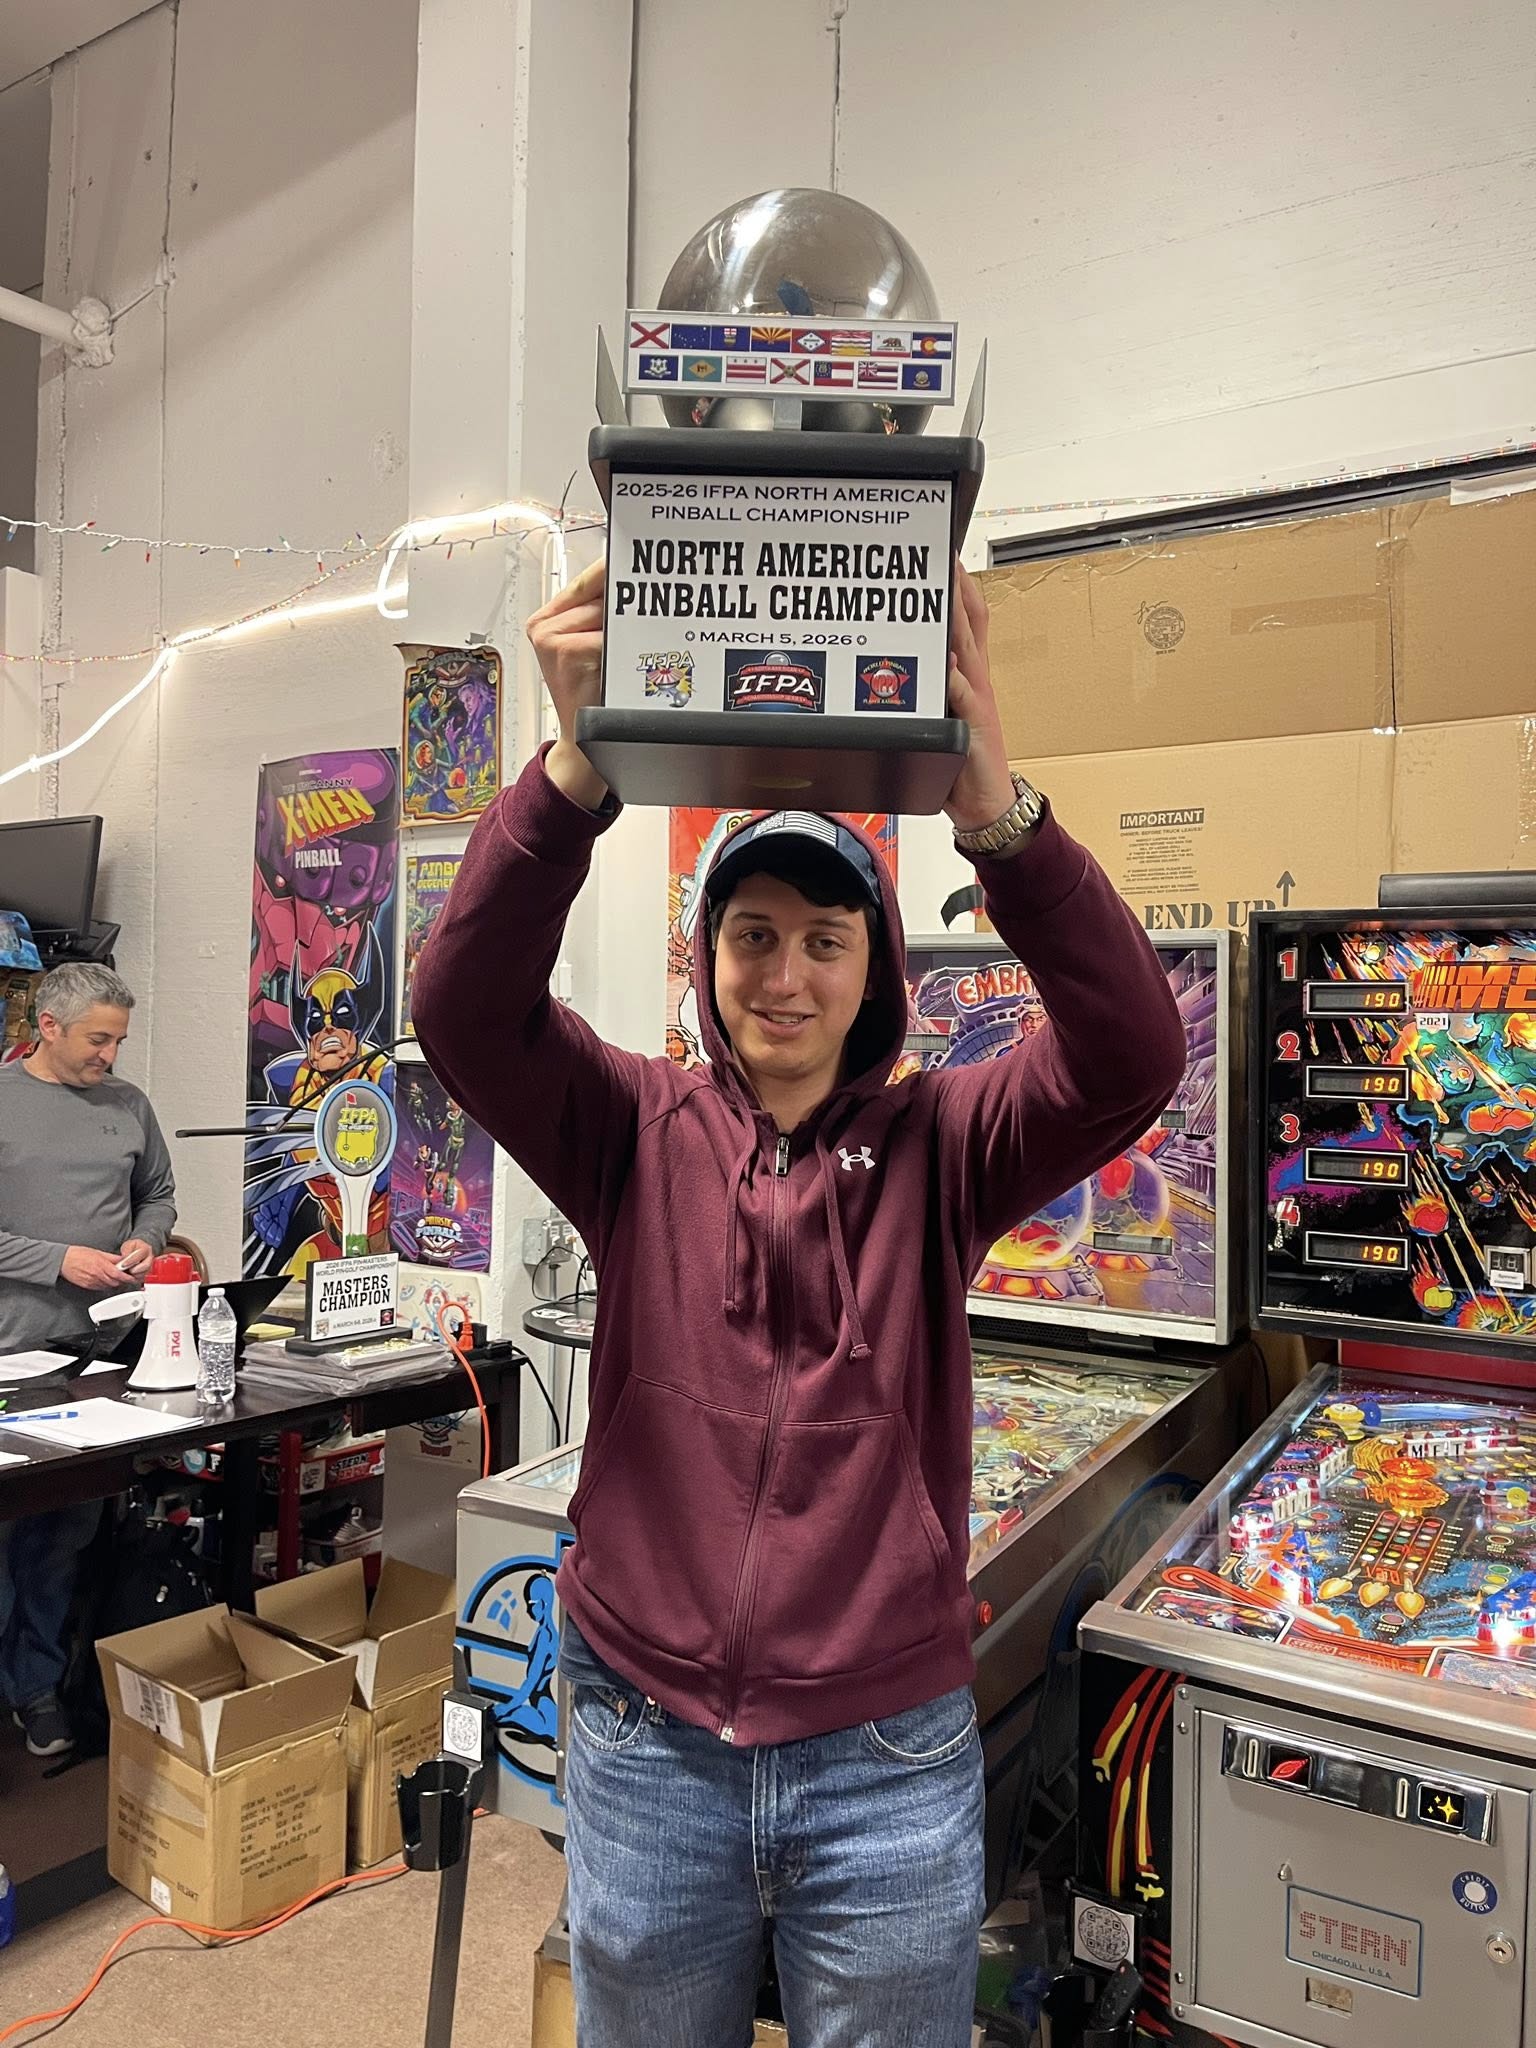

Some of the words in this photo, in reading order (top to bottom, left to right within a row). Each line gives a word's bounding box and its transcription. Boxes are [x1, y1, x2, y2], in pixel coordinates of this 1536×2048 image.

[616, 483, 697, 498] 2025-26
[704, 485, 748, 499] IFPA
[755, 486, 828, 501] NORTH
[833, 488, 945, 503] AMERICAN
[651, 506, 742, 521] PINBALL
[746, 508, 910, 524] CHAMPIONSHIP
[632, 539, 744, 576] NORTH
[757, 542, 929, 580] AMERICAN
[615, 581, 757, 619] PINBALL
[769, 584, 944, 623] CHAMPION
[700, 631, 774, 644] MARCH
[780, 633, 796, 645] 5,
[802, 634, 852, 646] 2026
[638, 651, 696, 671] IFPA
[733, 674, 815, 696] IFPA
[277, 787, 376, 855] X-MEN
[1122, 810, 1203, 827] IMPORTANT
[295, 848, 342, 869] PINBALL
[1144, 903, 1213, 929] END
[1280, 951, 1298, 979] 1
[1364, 992, 1400, 1008] 190
[1419, 1017, 1447, 1026] 2021
[1278, 1031, 1300, 1060] 2
[1363, 1077, 1400, 1092] 190
[338, 1108, 379, 1124] IFPA
[1280, 1114, 1299, 1142] 3
[1363, 1162, 1399, 1178] 190
[1362, 1245, 1399, 1262] 190
[323, 1274, 388, 1297] MASTERS
[319, 1289, 391, 1313] CHAMPION
[1299, 1910, 1407, 1967] STERN
